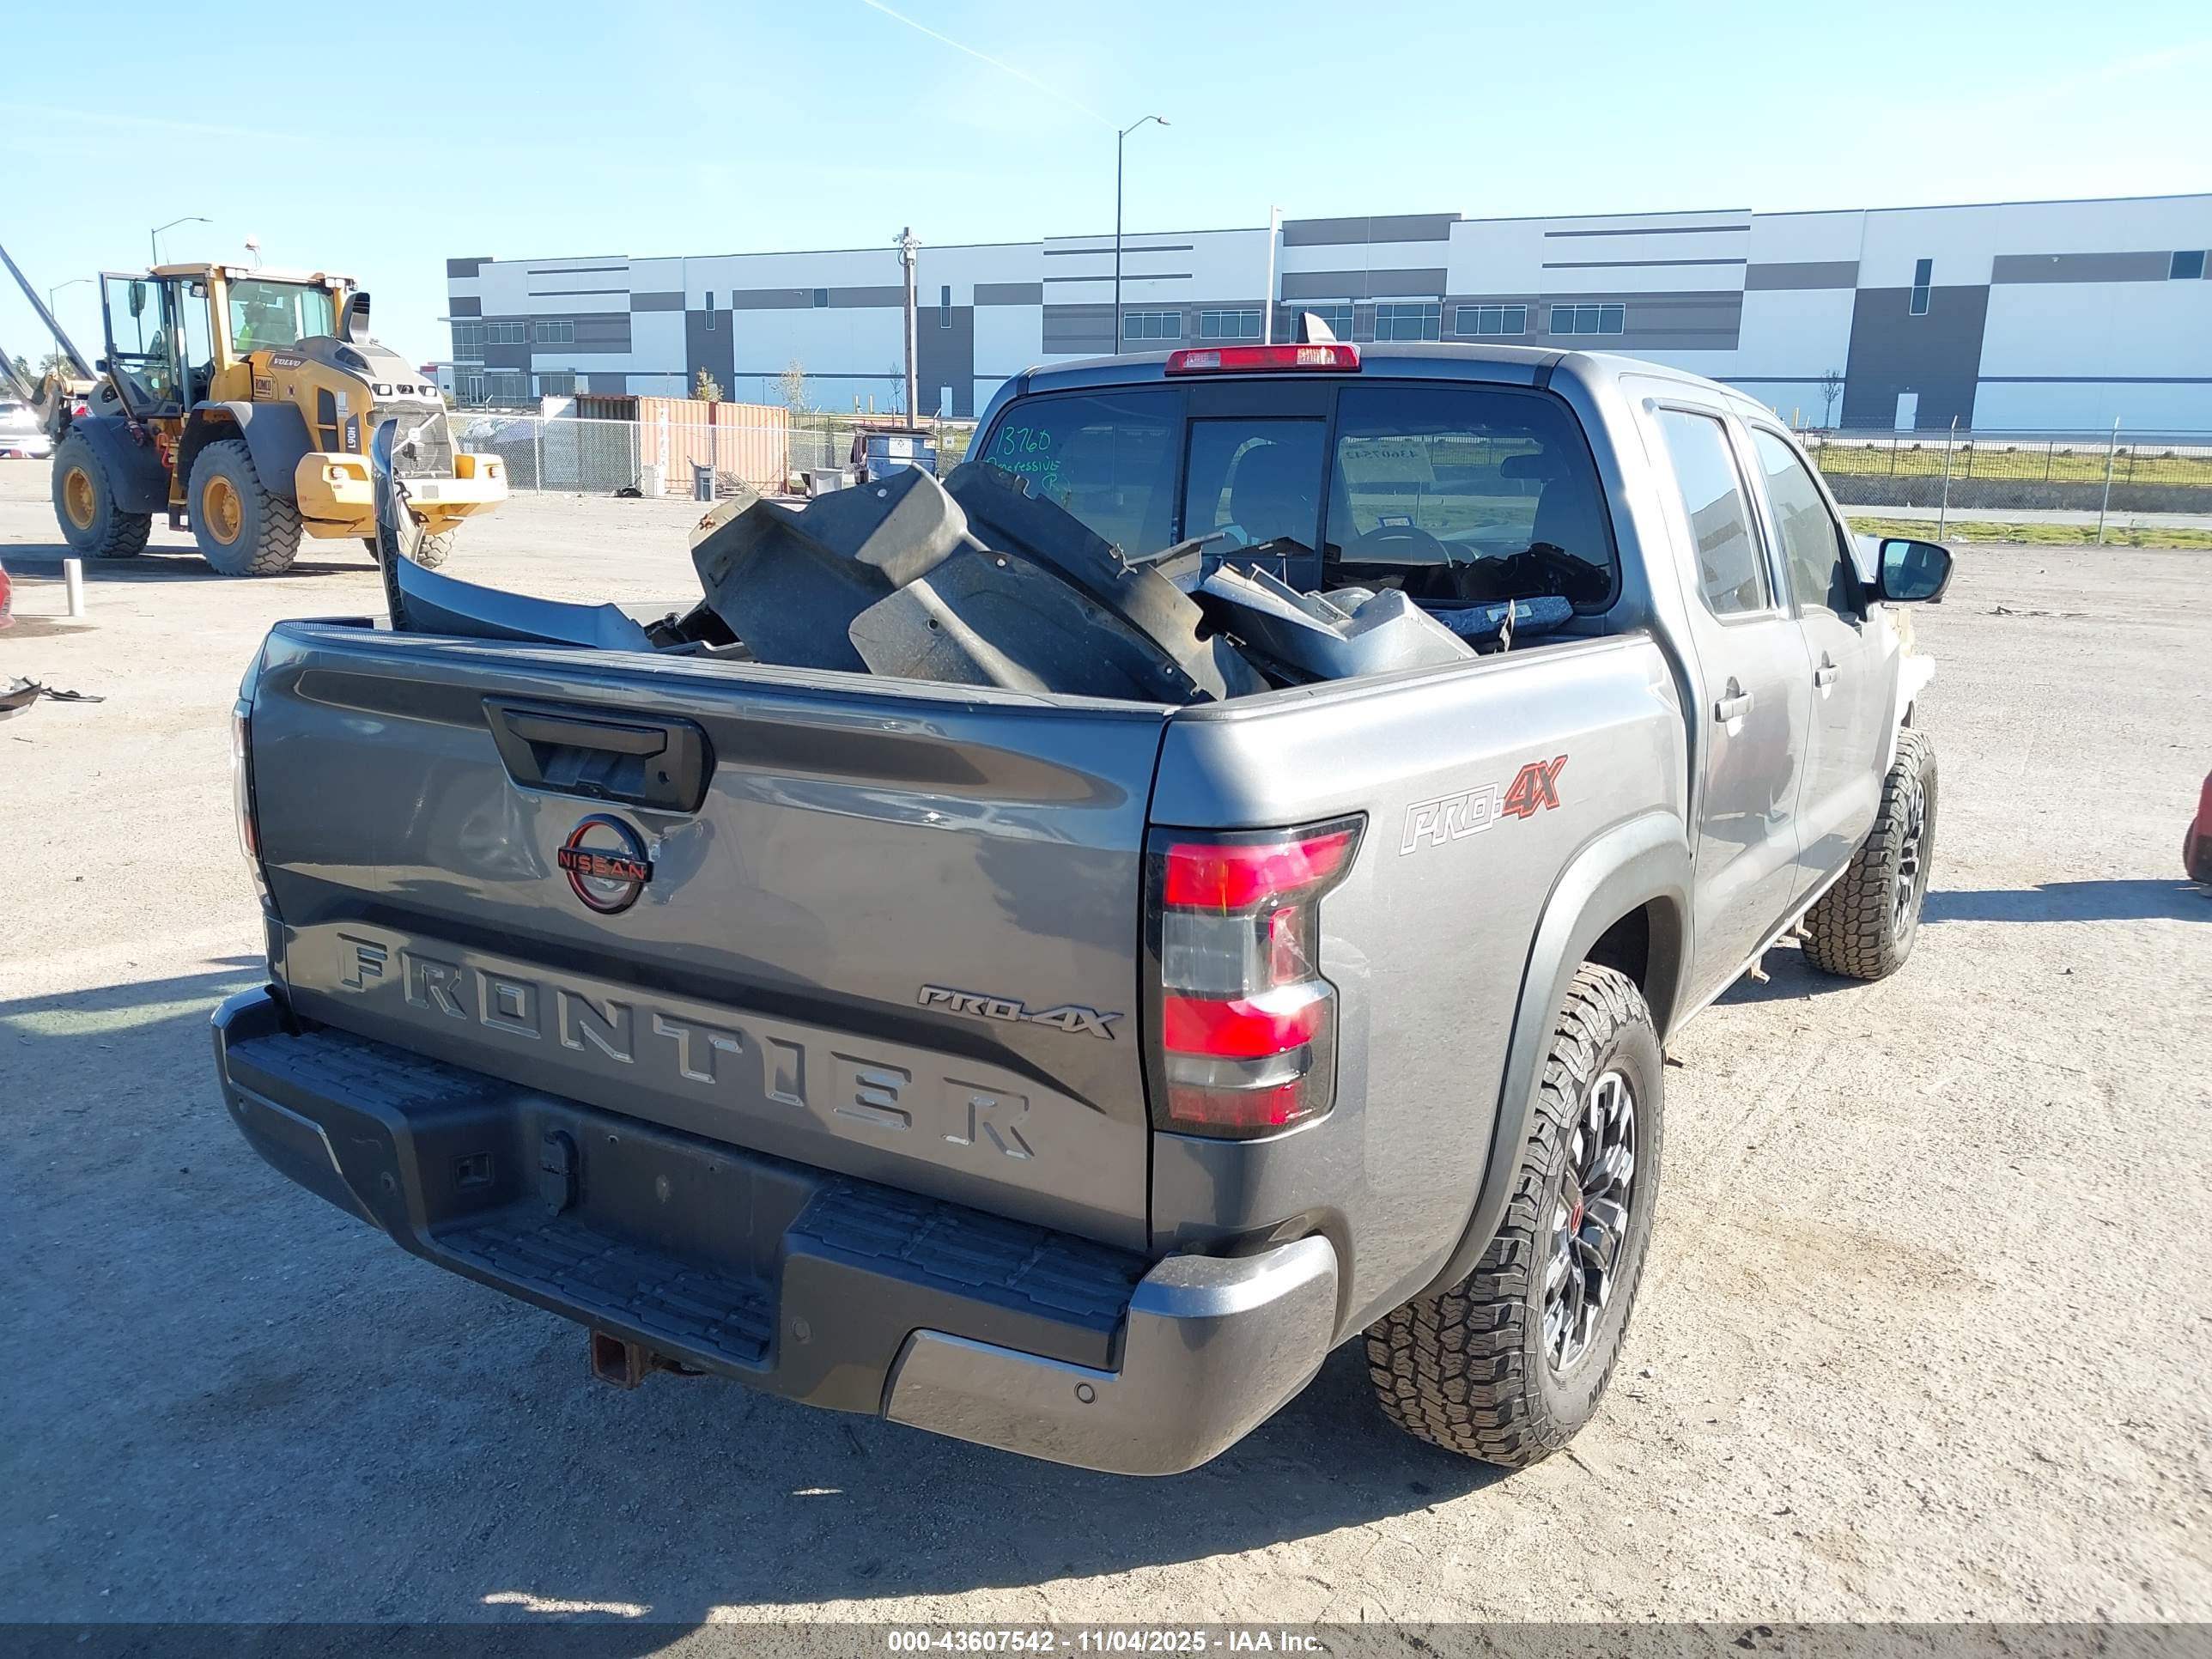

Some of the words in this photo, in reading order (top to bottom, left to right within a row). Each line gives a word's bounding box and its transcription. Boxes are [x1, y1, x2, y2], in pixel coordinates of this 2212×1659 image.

[274, 358, 301, 367] VOLVO
[347, 427, 356, 448] L90H
[1399, 754, 1569, 857] PRO-4X
[559, 850, 645, 880] NISSAN
[918, 984, 1124, 1040] PRO-4X
[337, 932, 1036, 1159] FRONTIER
